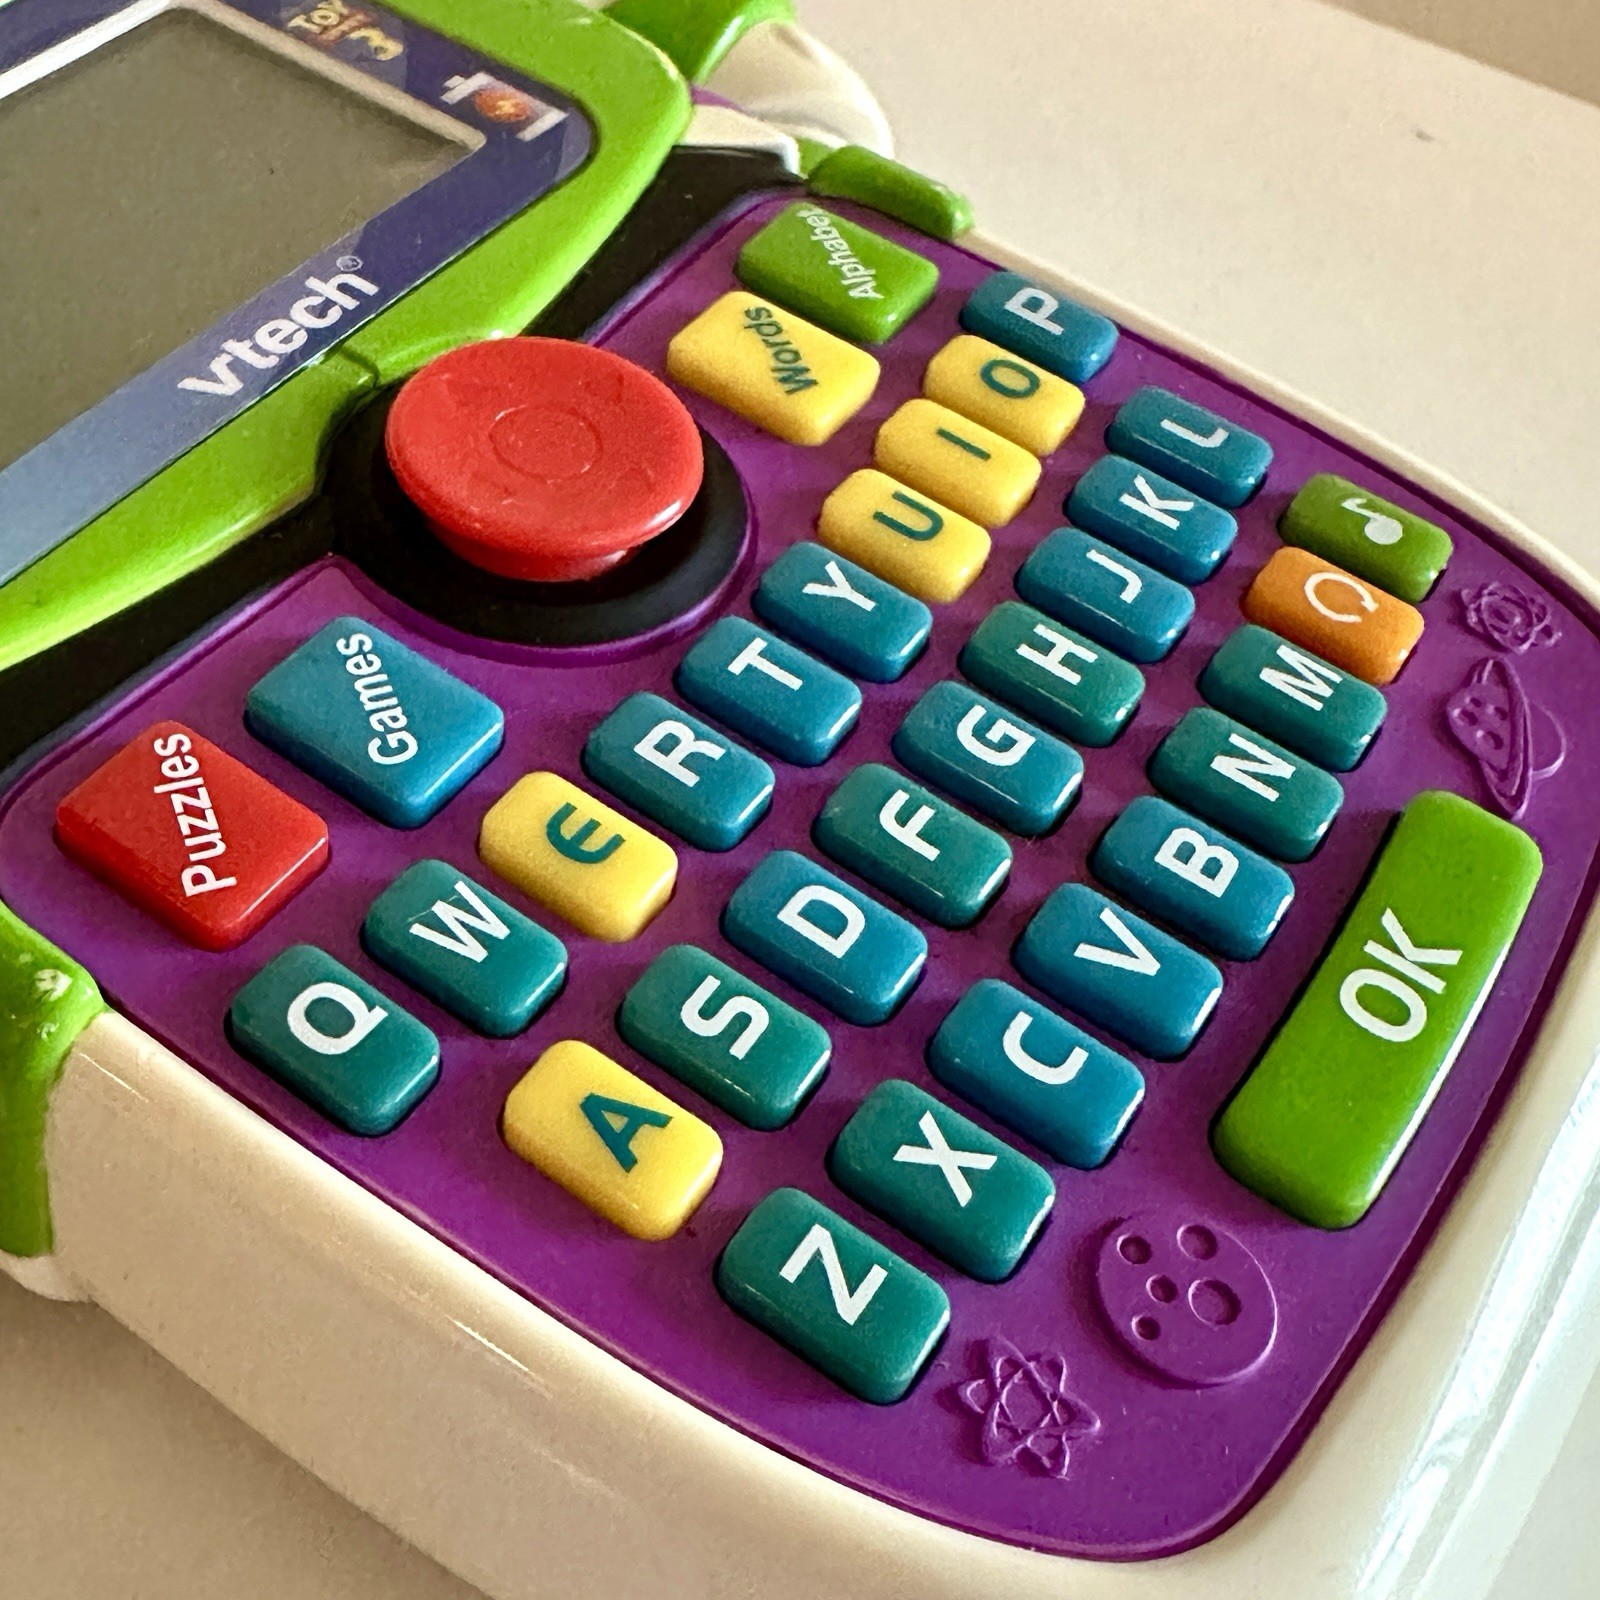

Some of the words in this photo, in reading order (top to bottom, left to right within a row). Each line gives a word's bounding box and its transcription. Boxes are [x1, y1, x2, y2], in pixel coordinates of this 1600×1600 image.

[796, 207, 884, 299] Alphabet
[1004, 287, 1064, 335] P
[744, 305, 818, 395] Words
[981, 360, 1039, 397] O
[936, 427, 991, 461] I
[1160, 419, 1229, 448] L
[872, 491, 944, 541] U
[1119, 474, 1194, 530] K
[802, 561, 876, 611] Y
[1086, 549, 1142, 603] J
[728, 637, 803, 690] T
[1016, 623, 1098, 685] H
[1259, 643, 1343, 711] M
[336, 632, 418, 764] Games
[633, 720, 726, 787] R
[957, 704, 1036, 766] G
[1210, 733, 1296, 802] N
[154, 734, 236, 896] Puzzles
[546, 803, 623, 864] E
[879, 789, 940, 861] F
[1154, 828, 1239, 897] B
[409, 881, 511, 963] W
[777, 885, 865, 958] D
[1074, 906, 1160, 976] V
[1340, 908, 1462, 1042] OK
[287, 982, 388, 1055] Q
[680, 975, 769, 1060] S
[1003, 1011, 1088, 1084] C
[580, 1093, 671, 1170] A
[893, 1110, 997, 1207] X
[779, 1223, 888, 1325] Z
